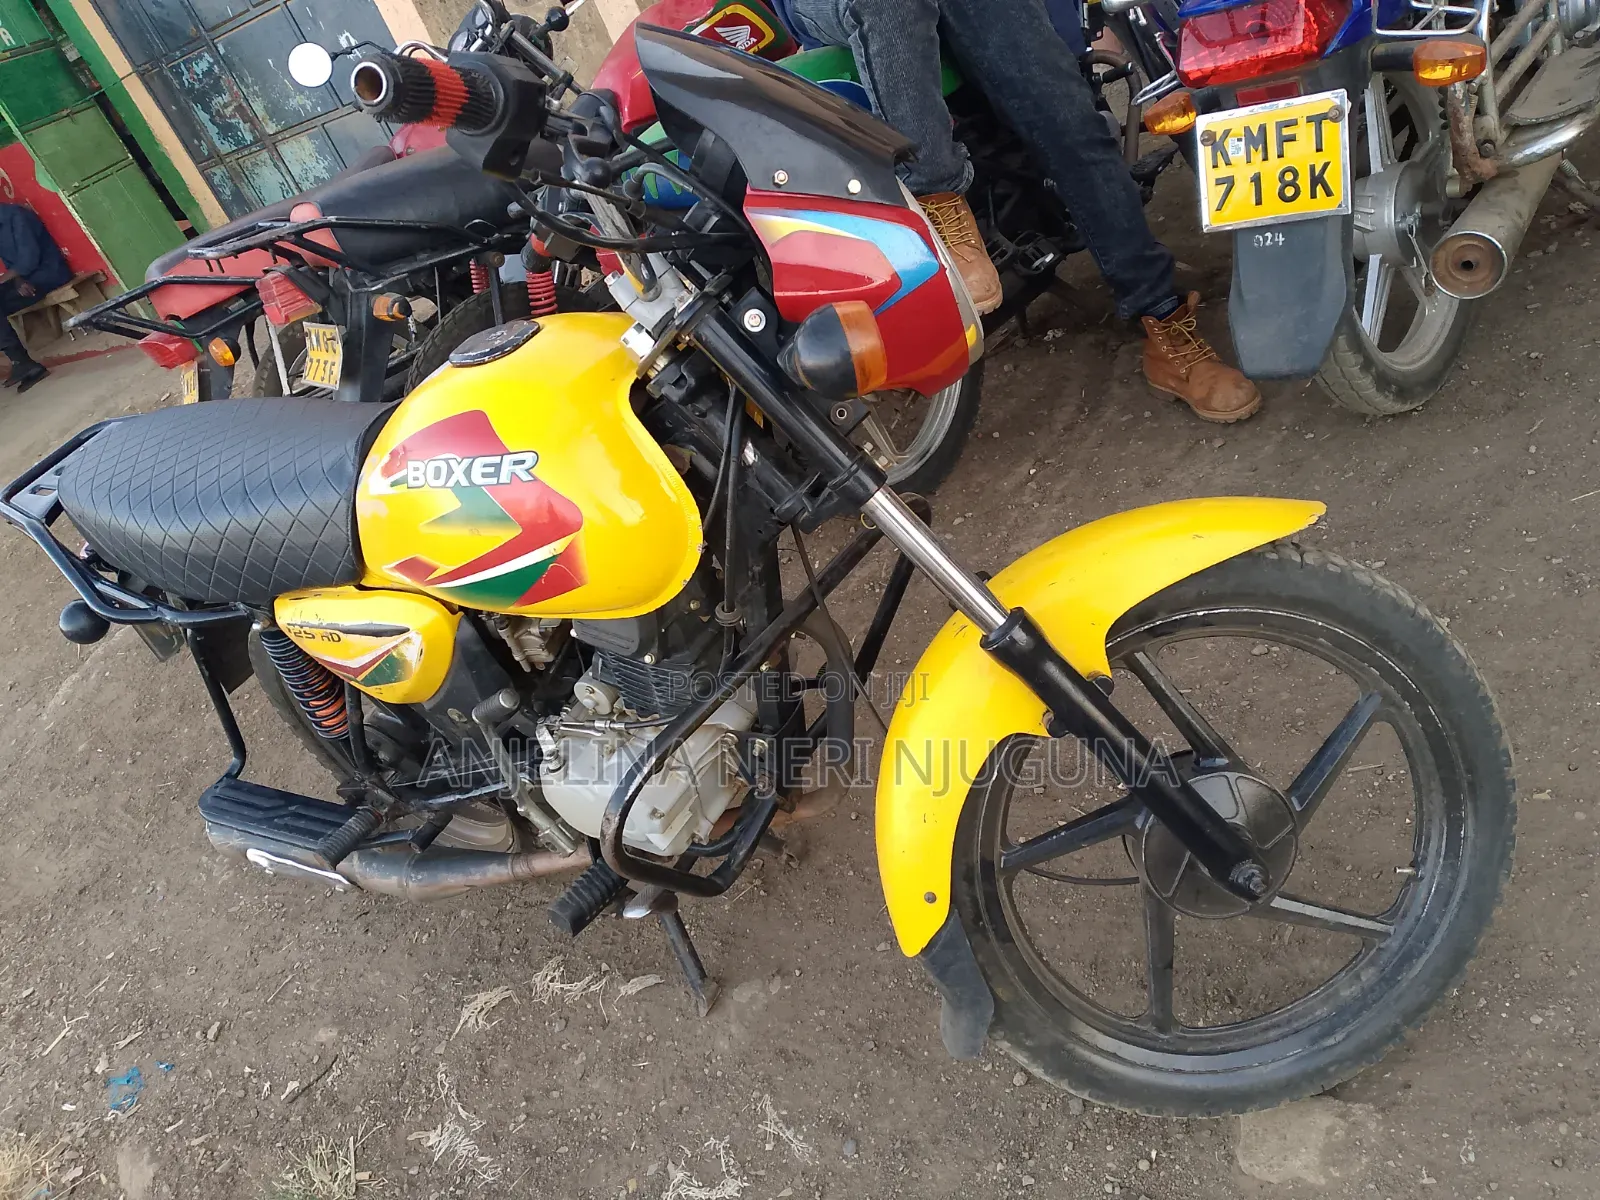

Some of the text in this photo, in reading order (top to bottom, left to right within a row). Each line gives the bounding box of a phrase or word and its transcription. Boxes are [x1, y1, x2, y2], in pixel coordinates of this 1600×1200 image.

[1210, 112, 1333, 169] KMFT
[1214, 161, 1335, 211] 718K
[406, 450, 540, 489] BOXER
